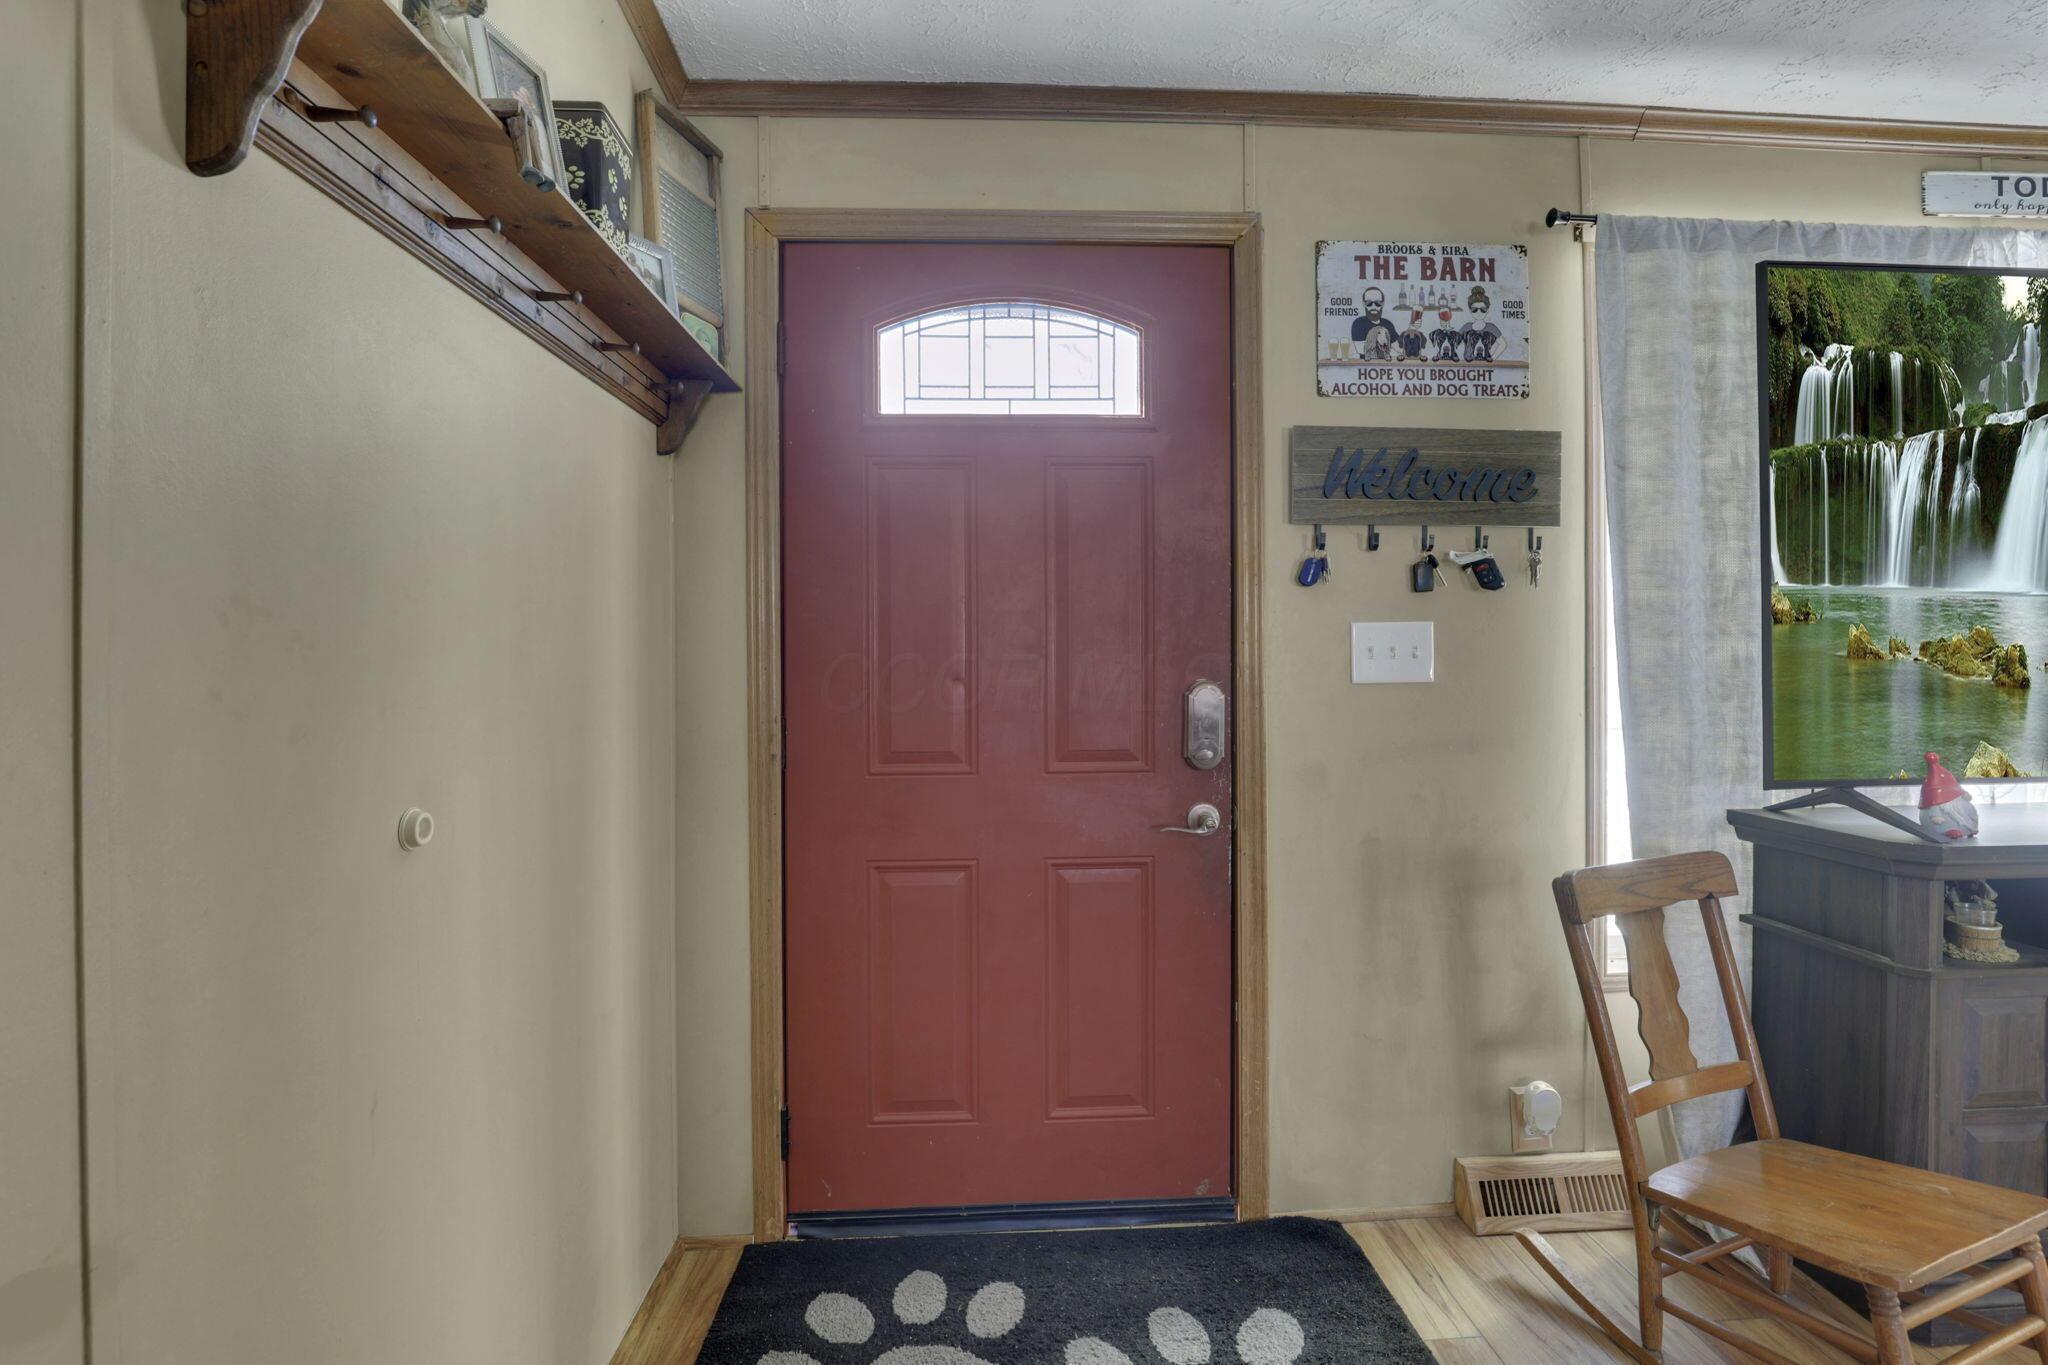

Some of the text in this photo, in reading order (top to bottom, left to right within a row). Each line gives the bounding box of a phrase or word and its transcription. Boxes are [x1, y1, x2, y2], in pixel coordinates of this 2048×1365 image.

[1974, 199, 2048, 215] only hap
[1378, 244, 1469, 256] BROOKS & KIRA
[1354, 255, 1496, 282] THE BARN
[1330, 297, 1352, 307] GOOD
[1502, 300, 1524, 309] GOOD
[1324, 307, 1359, 317] FRIENDS
[1501, 310, 1526, 320] TIMES
[1358, 368, 1494, 382] HOPE YOU BROUGHT
[1331, 383, 1519, 397] ALCOHOL AND DOG TREATS
[1322, 446, 1539, 503] Welcome
